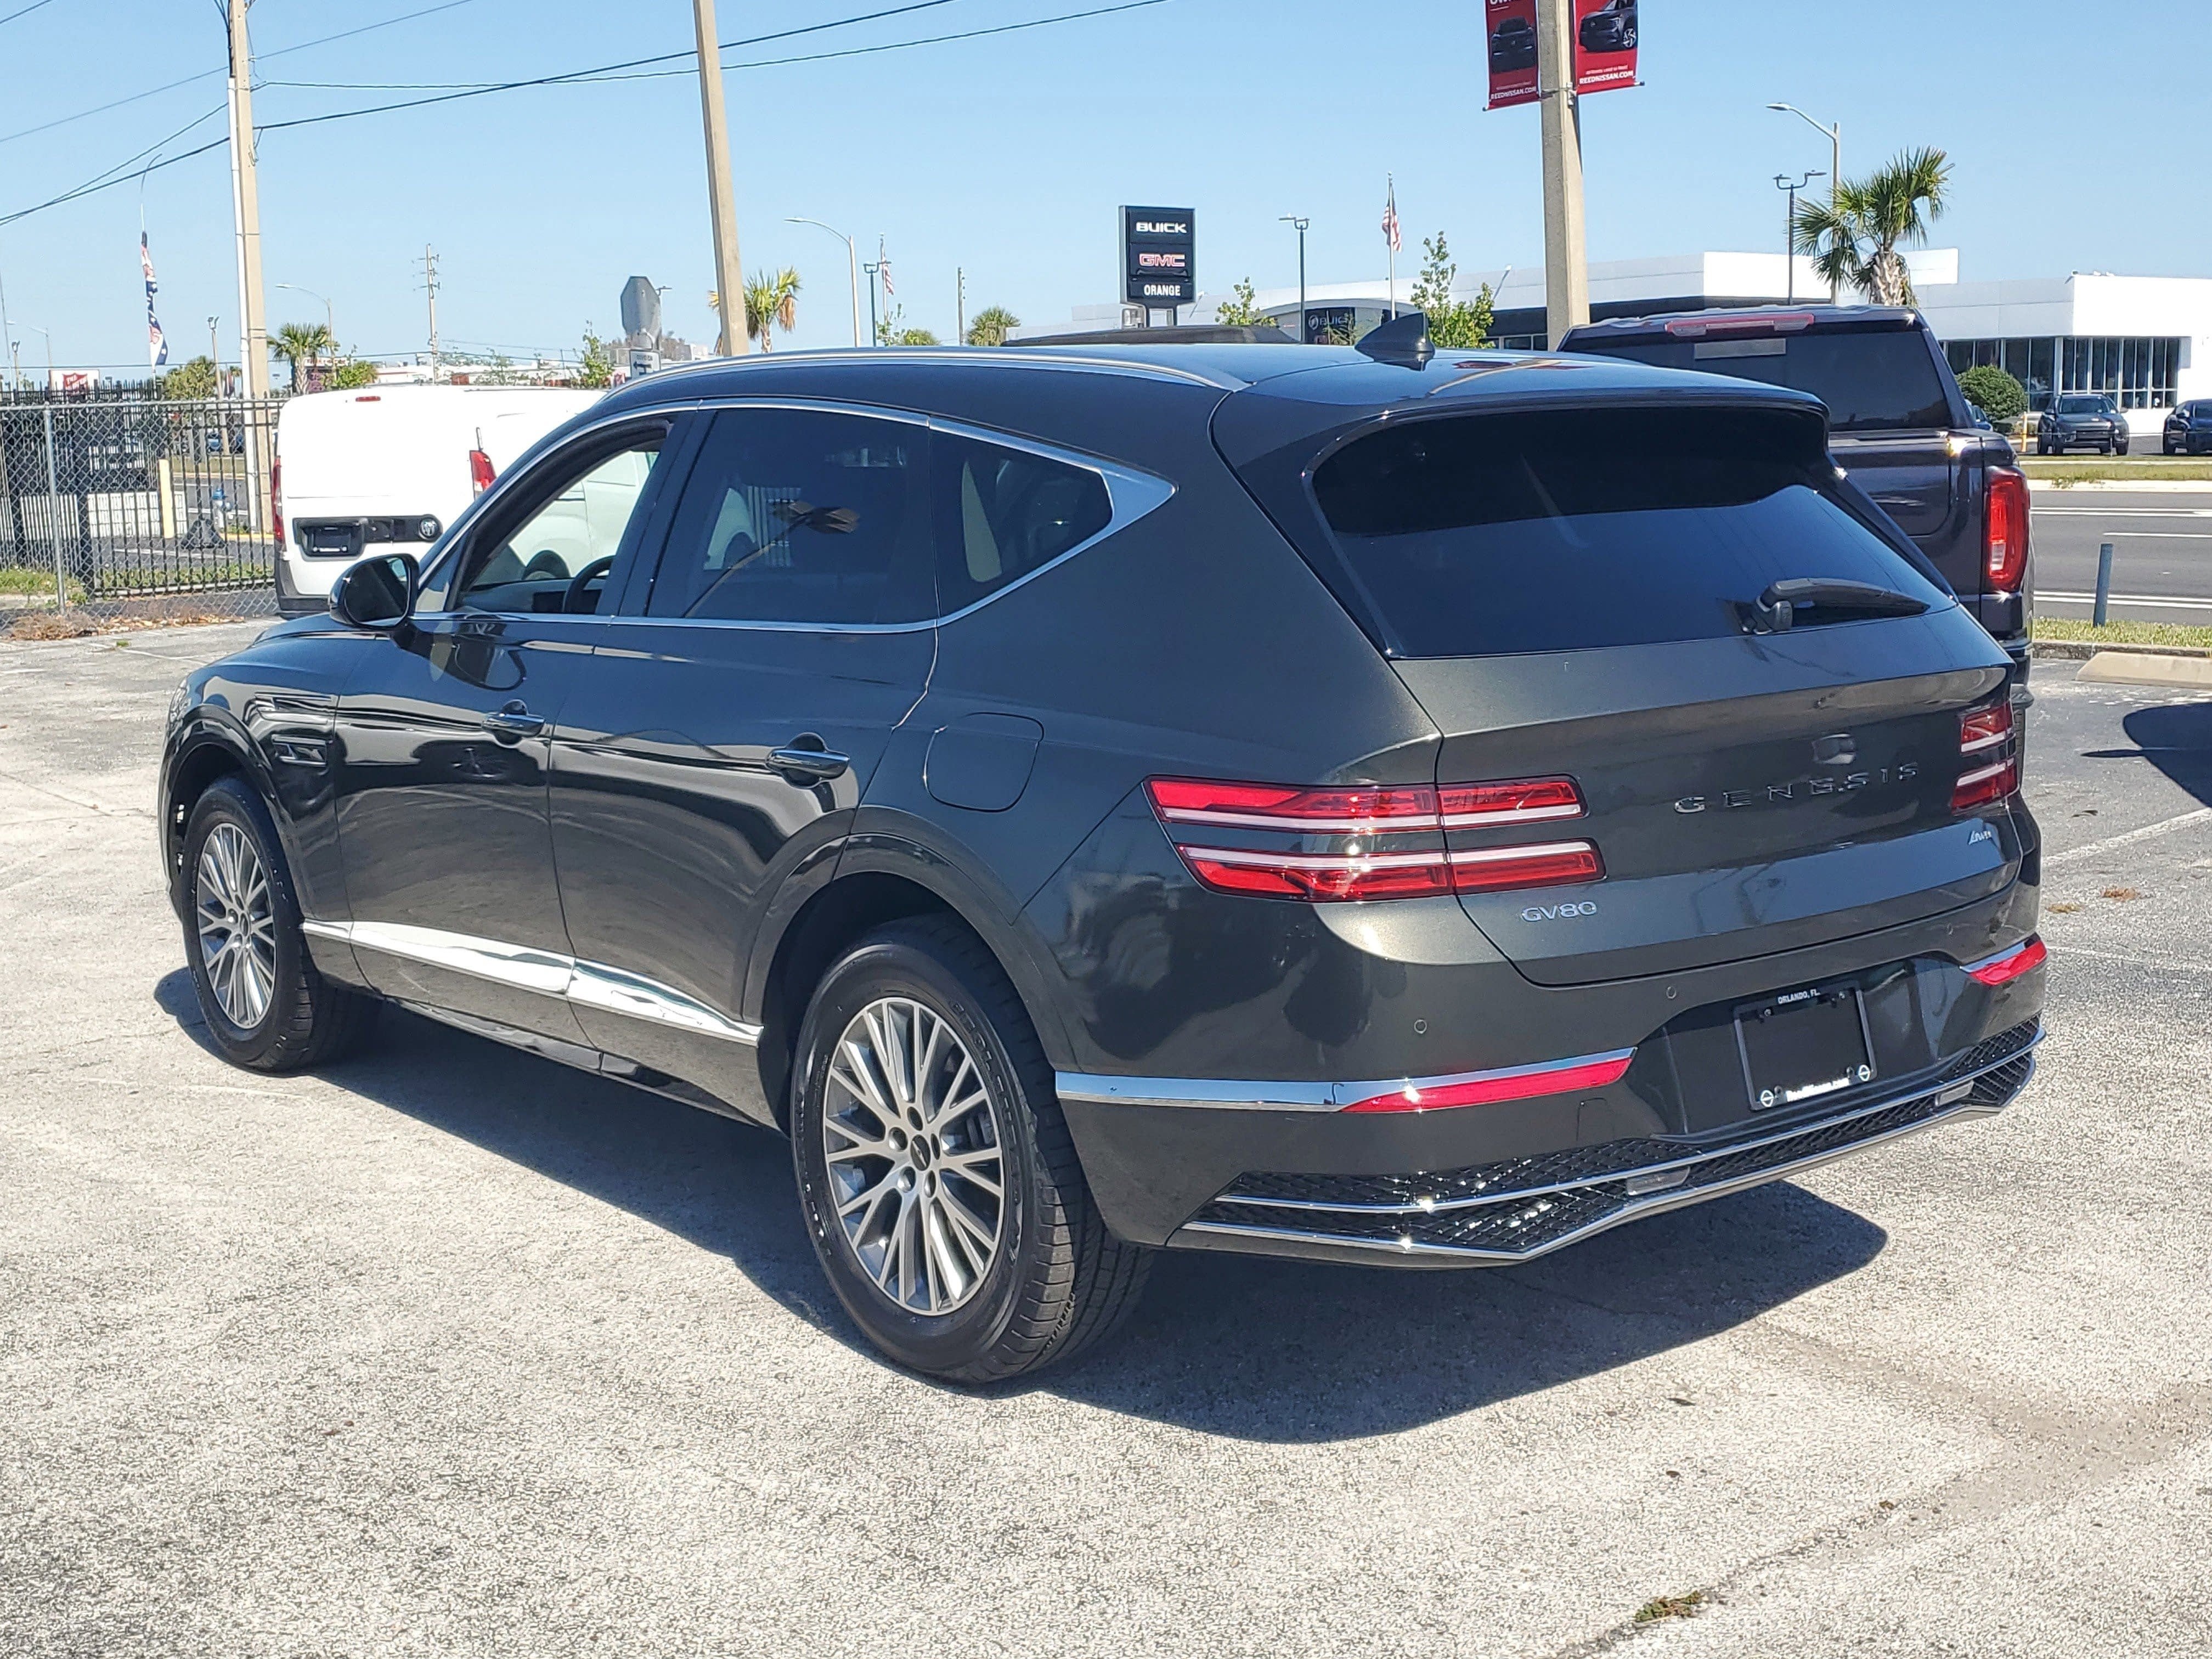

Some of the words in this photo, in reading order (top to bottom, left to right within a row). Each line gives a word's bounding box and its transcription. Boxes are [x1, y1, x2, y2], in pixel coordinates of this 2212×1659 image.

[1136, 222, 1187, 233] BUICK
[1139, 253, 1186, 267] GMC
[1144, 284, 1181, 296] ORANGE
[1674, 763, 1918, 814] GENESIS
[1521, 901, 1597, 922] GV80
[1778, 990, 1810, 1005] ORLANDO,
